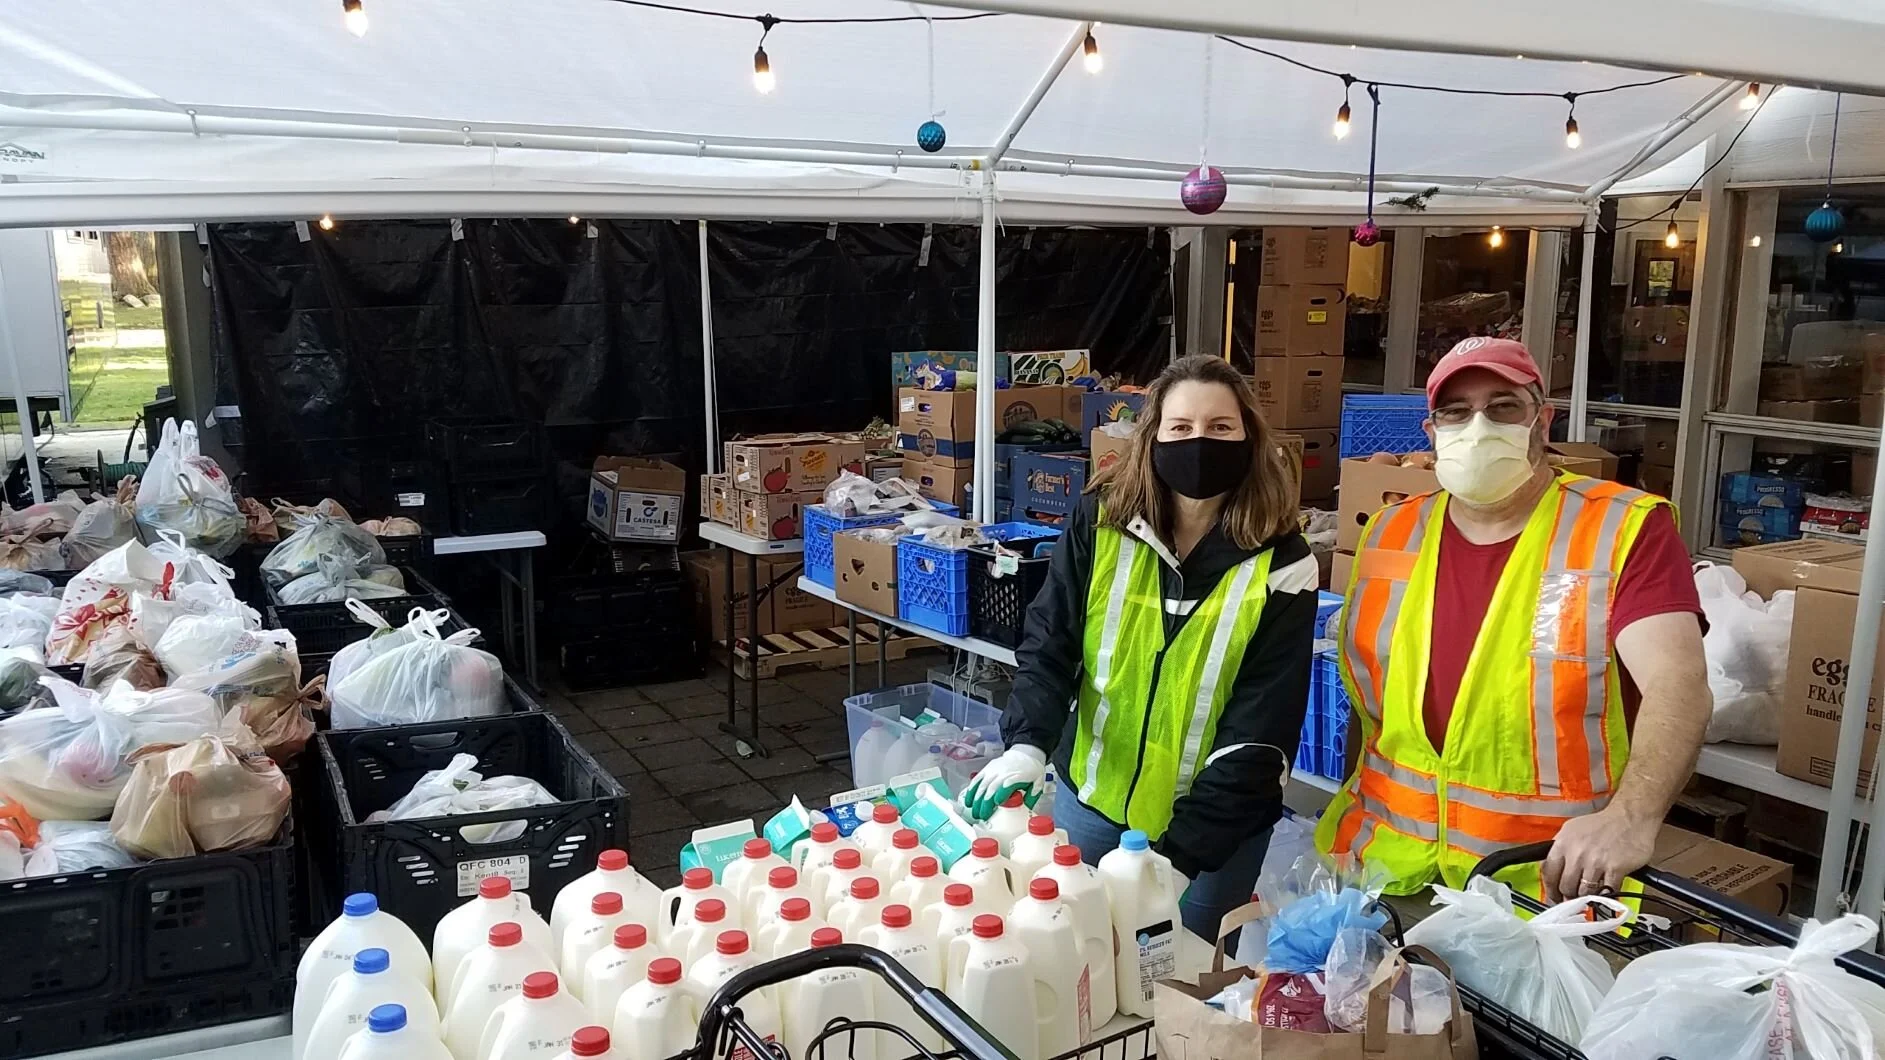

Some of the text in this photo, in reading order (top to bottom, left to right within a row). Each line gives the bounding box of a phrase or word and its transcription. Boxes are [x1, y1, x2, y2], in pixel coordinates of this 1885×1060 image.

[1811, 656, 1850, 687] eg
[459, 856, 526, 871] QFC 804 D
